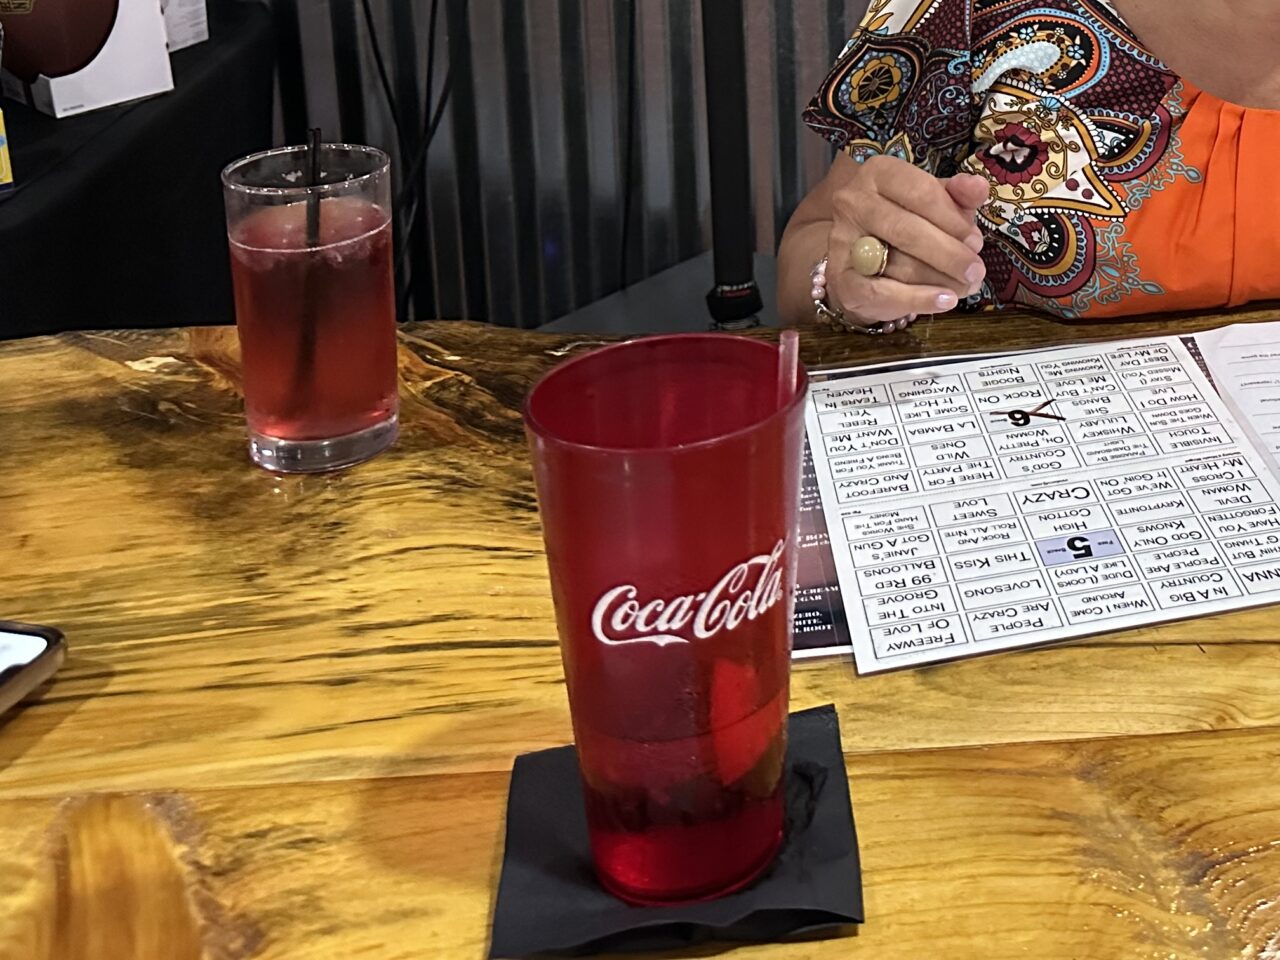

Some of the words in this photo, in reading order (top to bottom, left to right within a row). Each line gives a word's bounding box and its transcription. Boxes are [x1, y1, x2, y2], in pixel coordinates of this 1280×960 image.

[911, 377, 938, 386] YOU
[898, 385, 960, 398] WATCHING
[843, 409, 871, 418] YELL
[1005, 408, 1031, 426] 6
[839, 417, 878, 428] REBEL
[956, 420, 976, 429] LA
[1079, 415, 1128, 429] LULLABY
[908, 423, 955, 436] BAMBA
[1082, 425, 1136, 439] WHISKEY
[1168, 426, 1211, 438] TOUCH
[1170, 435, 1223, 449] INVISIBLE
[1008, 448, 1066, 463] COUNTRY
[1021, 461, 1062, 473] GOD'S
[1180, 461, 1220, 474] HEART
[1222, 457, 1244, 468] MY
[838, 477, 880, 489] CRAZY
[882, 472, 910, 482] AND
[1191, 471, 1235, 483] CROSS
[845, 483, 910, 499] BAREFOOT
[1201, 482, 1252, 496] WOMAN
[1022, 486, 1091, 506] CRAZY
[1214, 494, 1253, 506] DEVIL
[954, 497, 989, 509] LOVE
[1115, 499, 1185, 516] KRYPTONITE
[952, 508, 998, 521] SWEET
[1038, 507, 1092, 522] COTTON
[1207, 506, 1277, 523] FORGOTTEN
[1053, 521, 1088, 532] HIGH
[1136, 519, 1186, 533] KNOWS
[1218, 523, 1248, 533] YOU
[1248, 517, 1280, 529] HAVE
[902, 533, 930, 544] GOT
[1171, 530, 1203, 541] GOD
[853, 541, 884, 551] GUN
[886, 538, 898, 548] A
[1066, 536, 1094, 560] 5
[1133, 536, 1169, 548] ONLY
[1223, 537, 1264, 549] THANG
[871, 547, 919, 561] JANIE'S
[994, 551, 1031, 563] THIS
[1154, 547, 1200, 560] PEOPLE
[1232, 550, 1257, 560] BUT
[860, 559, 936, 578] BALLOONS
[953, 557, 991, 570] KISS
[1145, 563, 1171, 574] ARE
[1175, 556, 1220, 570] PEOPLE
[874, 578, 907, 590] RED
[911, 574, 932, 586] 99
[1160, 572, 1224, 590] COUNTRY
[591, 537, 787, 646] Coca-Cola
[963, 578, 1042, 598] LOVESONG
[1196, 588, 1209, 600] A
[1212, 586, 1229, 597] IN
[876, 589, 939, 606] GROOVE
[1081, 590, 1125, 604] AROUND
[1169, 591, 1197, 603] BIG
[911, 602, 946, 614] INTO
[1021, 601, 1050, 613] ARE
[1105, 604, 1112, 614] I
[1112, 599, 1149, 610] WHEN
[878, 609, 910, 620] THE
[972, 607, 1018, 622] CRAZY
[1070, 606, 1104, 618] COME
[882, 622, 923, 637] LOVE
[927, 618, 950, 630] OF
[989, 617, 1045, 633] PEOPLE
[886, 632, 956, 652] FREEWAY
